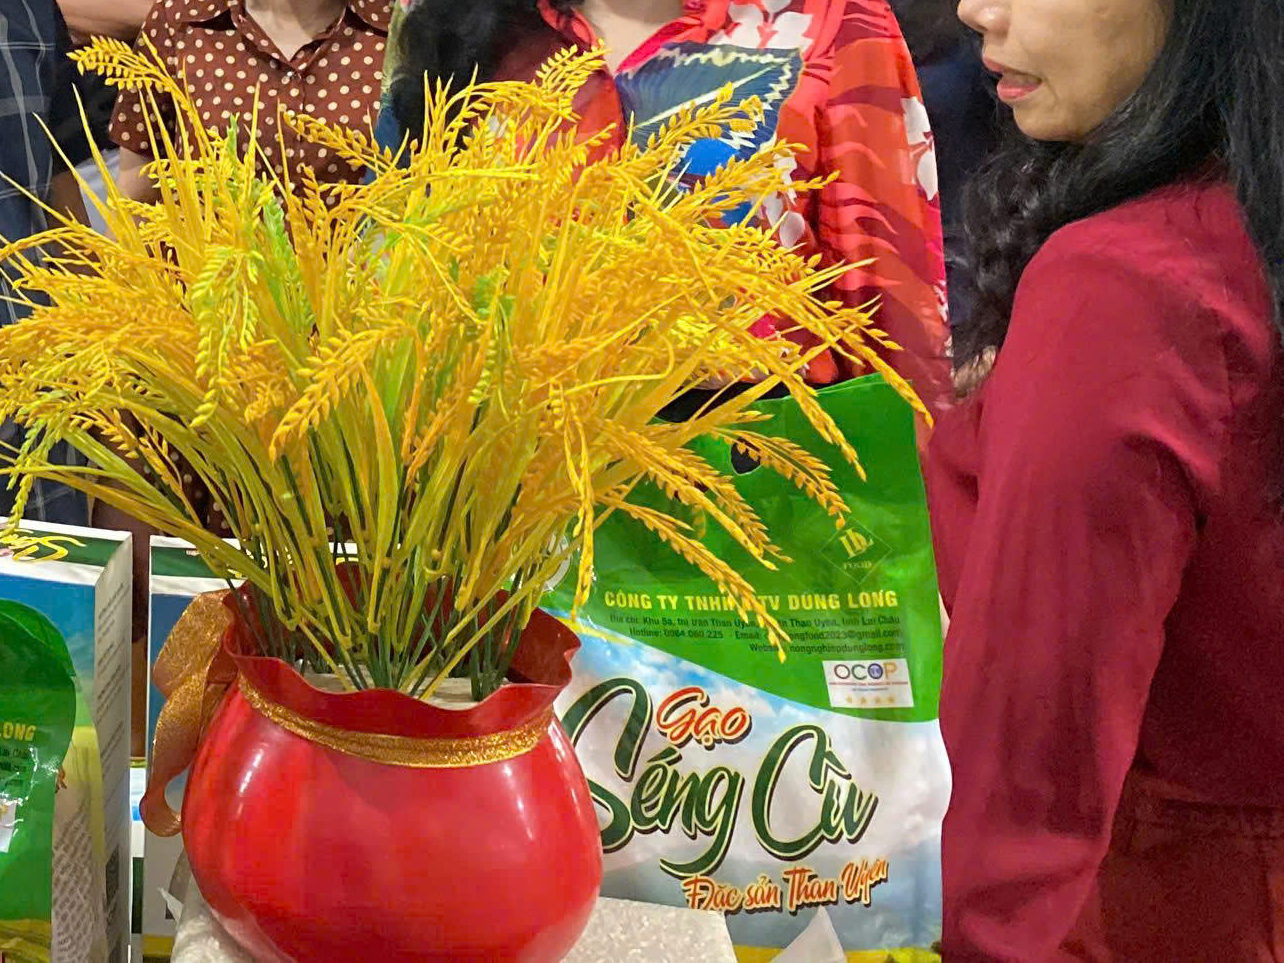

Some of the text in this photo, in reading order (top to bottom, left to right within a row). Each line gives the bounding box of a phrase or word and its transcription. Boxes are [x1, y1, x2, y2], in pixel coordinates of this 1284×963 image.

[604, 589, 652, 610] CÔNG
[657, 595, 678, 611] TY
[847, 589, 899, 609] LONG
[834, 662, 898, 680] OCOP
[656, 687, 751, 751] Gạo
[560, 677, 878, 880] Séng Cù
[745, 872, 783, 910] sản
[783, 866, 838, 915] Than
